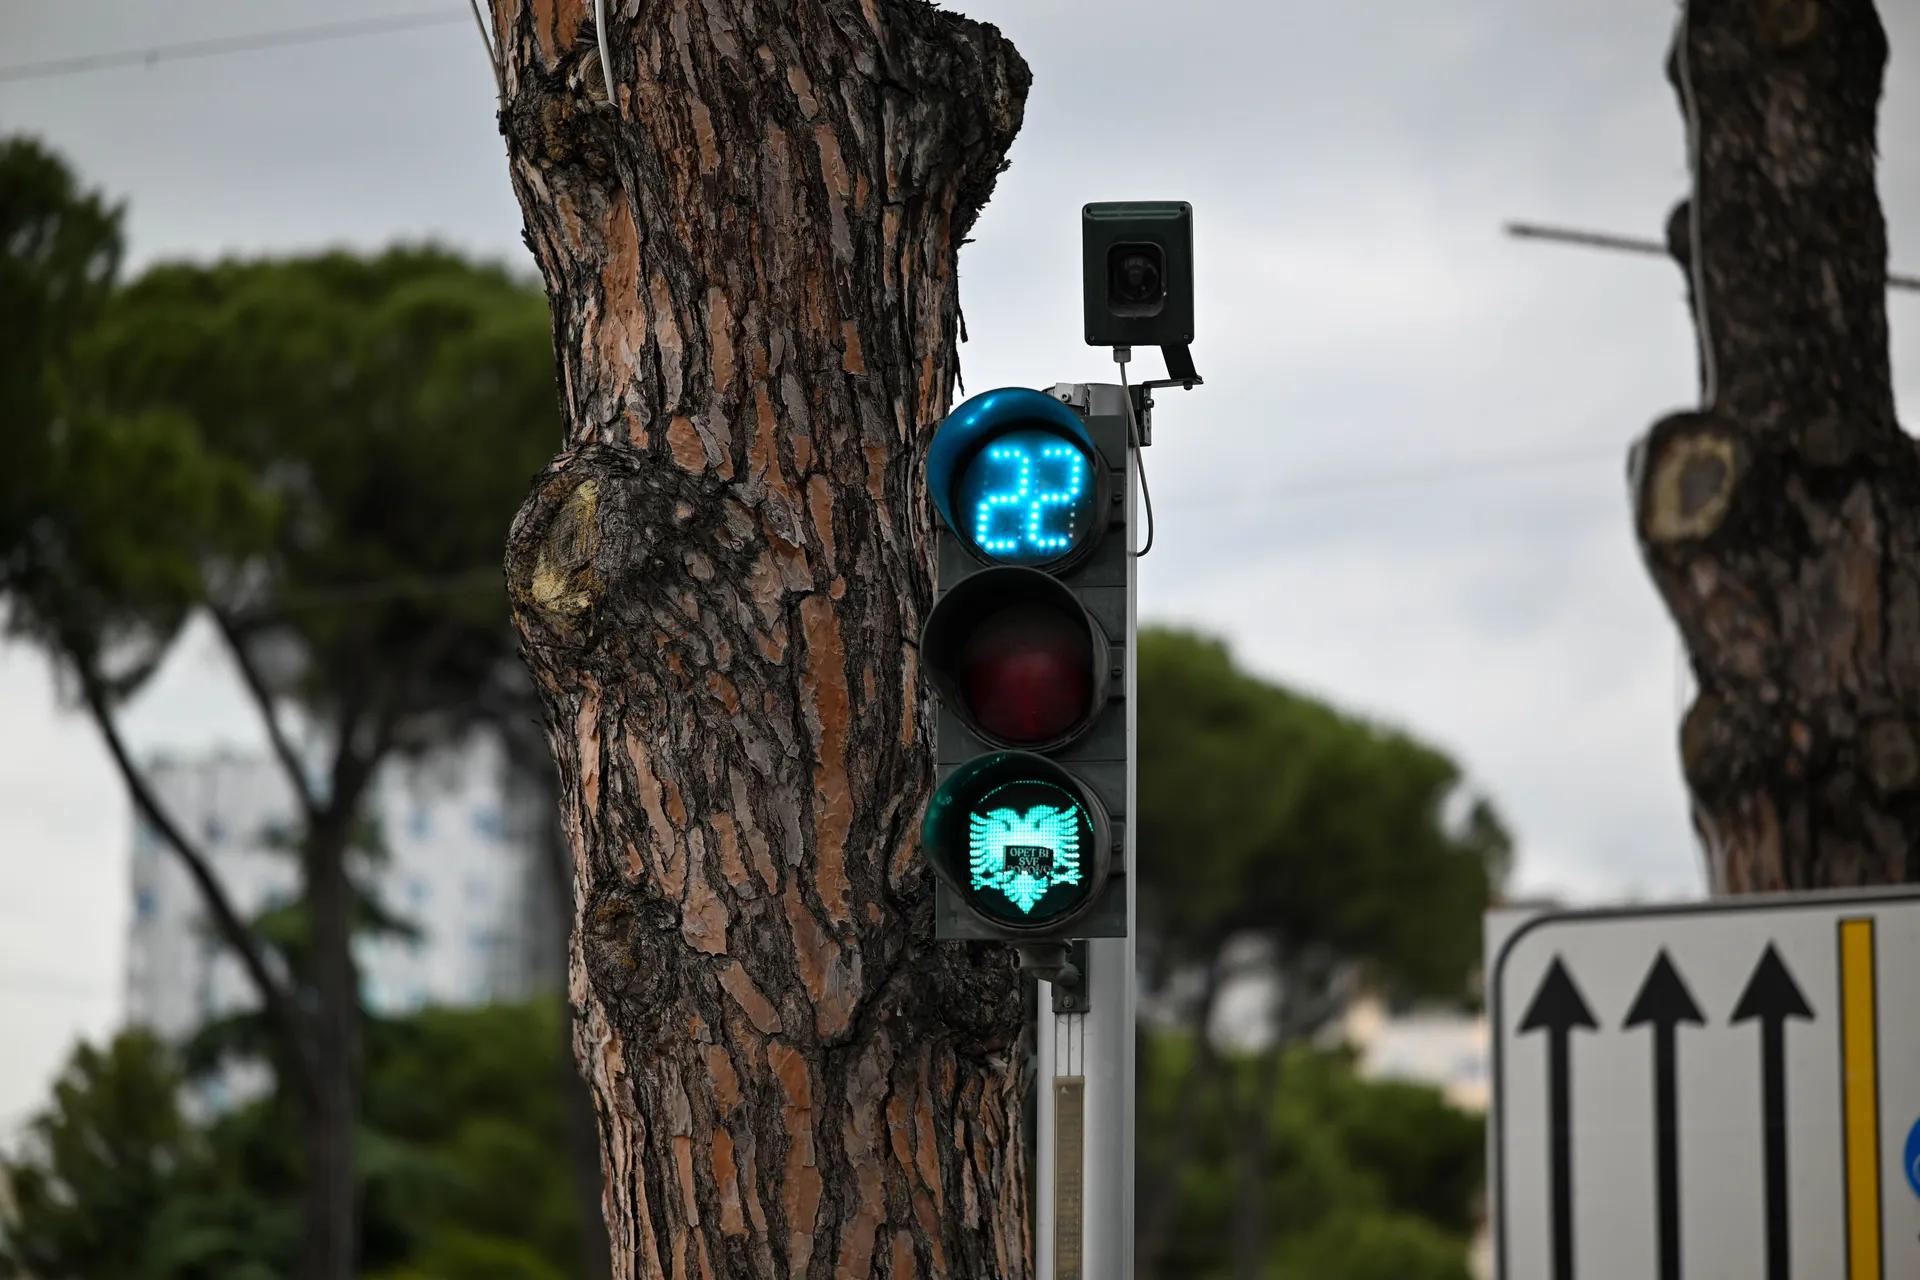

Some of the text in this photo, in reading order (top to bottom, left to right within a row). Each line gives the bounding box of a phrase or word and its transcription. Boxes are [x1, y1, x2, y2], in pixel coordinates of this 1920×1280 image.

[976, 445, 1083, 550] 22
[1009, 848, 1049, 858] OPET BI
